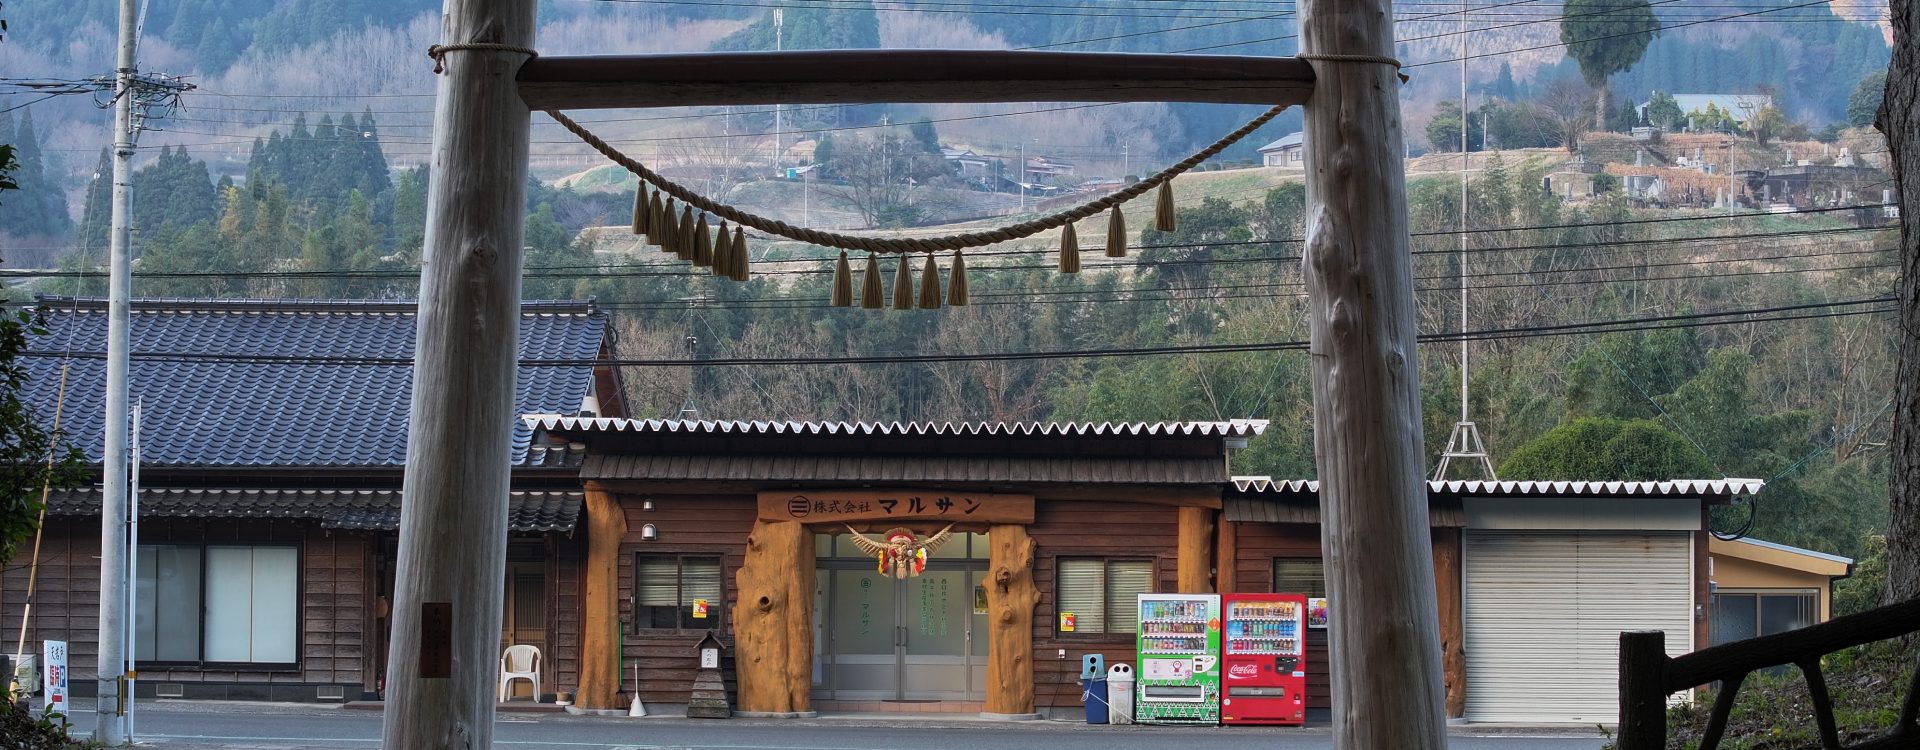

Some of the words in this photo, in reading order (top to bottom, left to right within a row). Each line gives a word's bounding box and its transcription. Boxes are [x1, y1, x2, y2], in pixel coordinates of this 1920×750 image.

[813, 500, 872, 514] 株式会社
[878, 496, 982, 515] マルサン
[861, 603, 870, 635] マルサン
[1230, 664, 1258, 675] Coca-Cola
